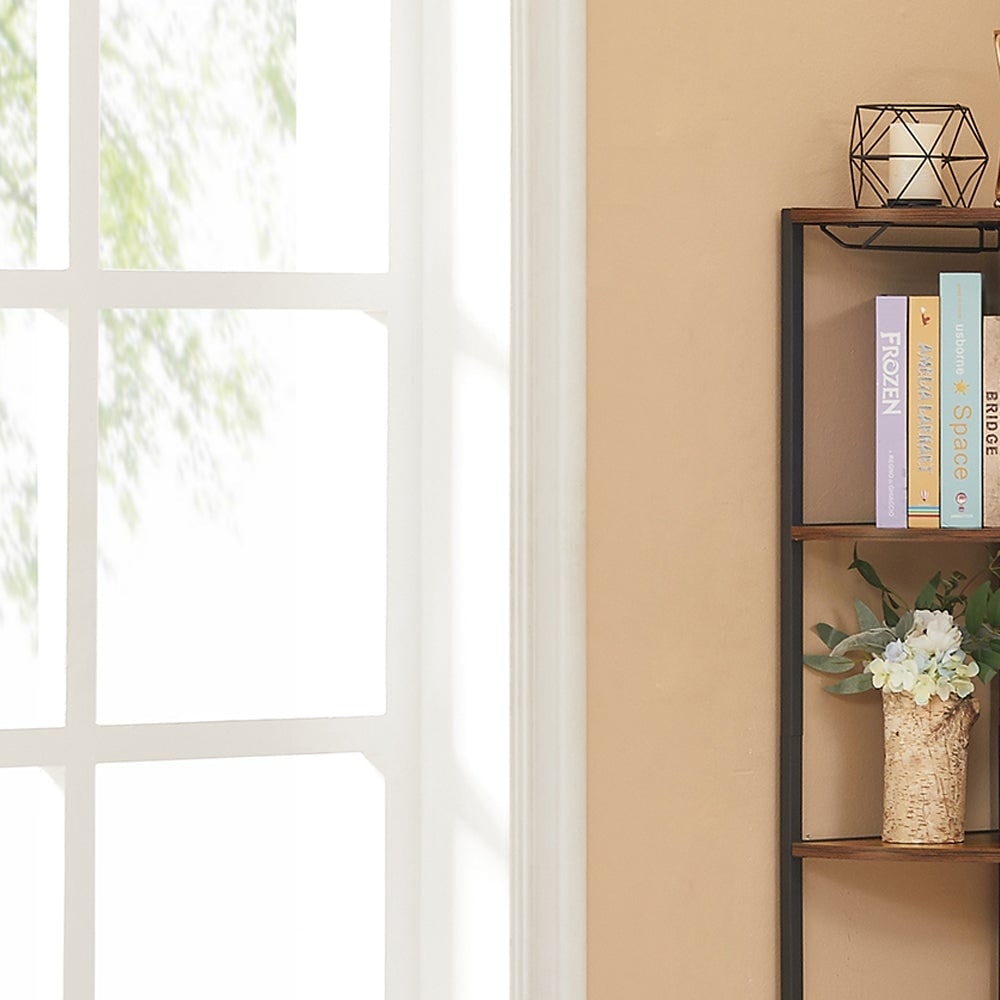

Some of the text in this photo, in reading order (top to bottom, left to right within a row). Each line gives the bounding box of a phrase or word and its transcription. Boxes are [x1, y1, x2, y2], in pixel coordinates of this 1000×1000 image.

[880, 331, 902, 416] FROZEN
[955, 323, 967, 375] usborne
[949, 404, 973, 480] Space
[985, 391, 998, 456] BRIDGE
